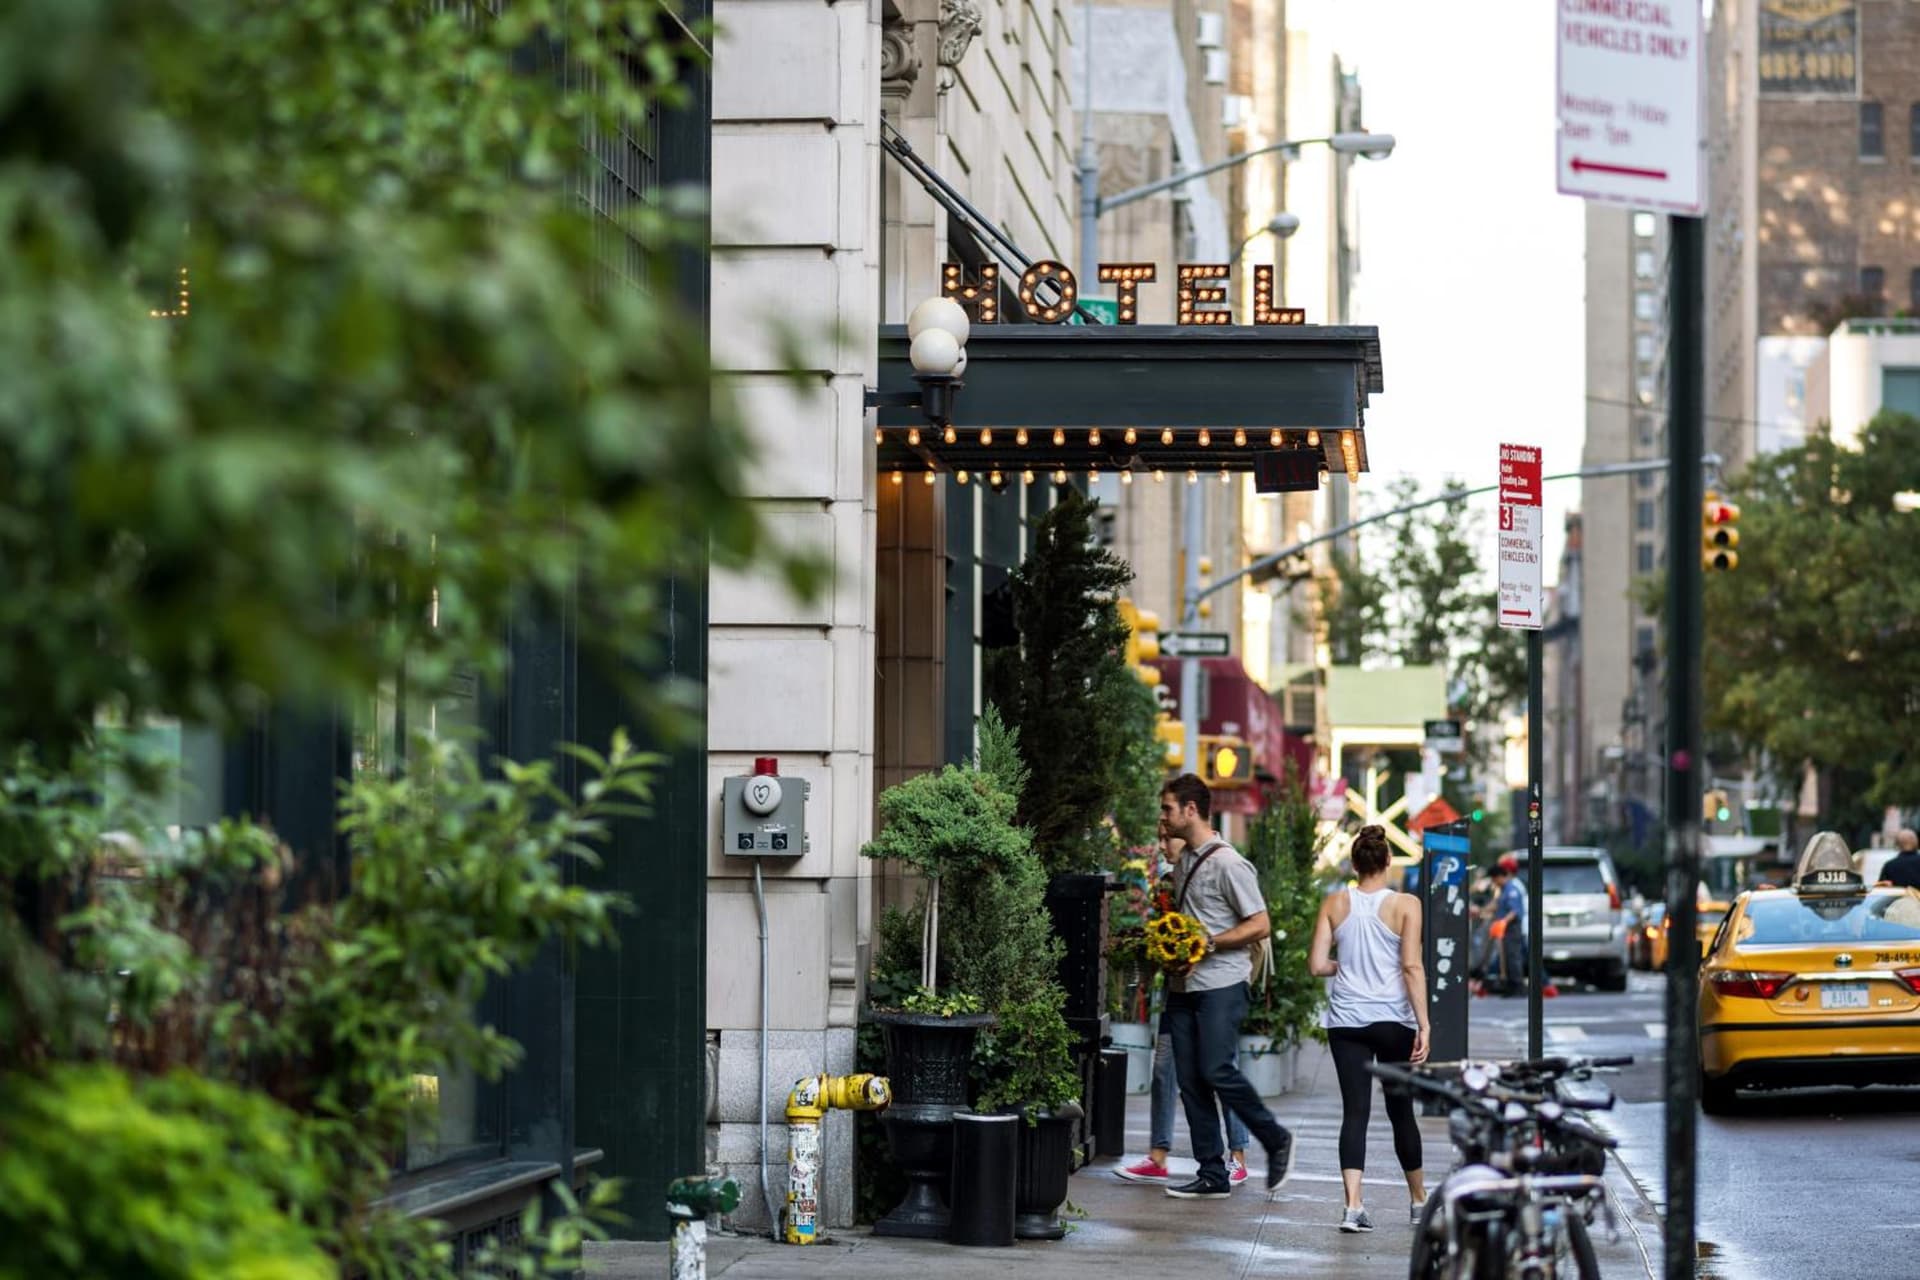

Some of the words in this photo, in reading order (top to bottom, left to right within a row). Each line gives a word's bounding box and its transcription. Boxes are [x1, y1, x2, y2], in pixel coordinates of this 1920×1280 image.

[1564, 22, 1643, 54] VEHICLES
[1647, 33, 1689, 60] ONLY
[941, 259, 1306, 326] HOTEL
[1501, 448, 1510, 460] NO
[1510, 449, 1536, 463] STANDING
[1502, 507, 1510, 528] 3
[1501, 537, 1533, 550] COMMERCIAL
[1501, 551, 1525, 562] VEHICLES
[1525, 552, 1538, 564] ONLY
[1817, 872, 1847, 883] 8J18
